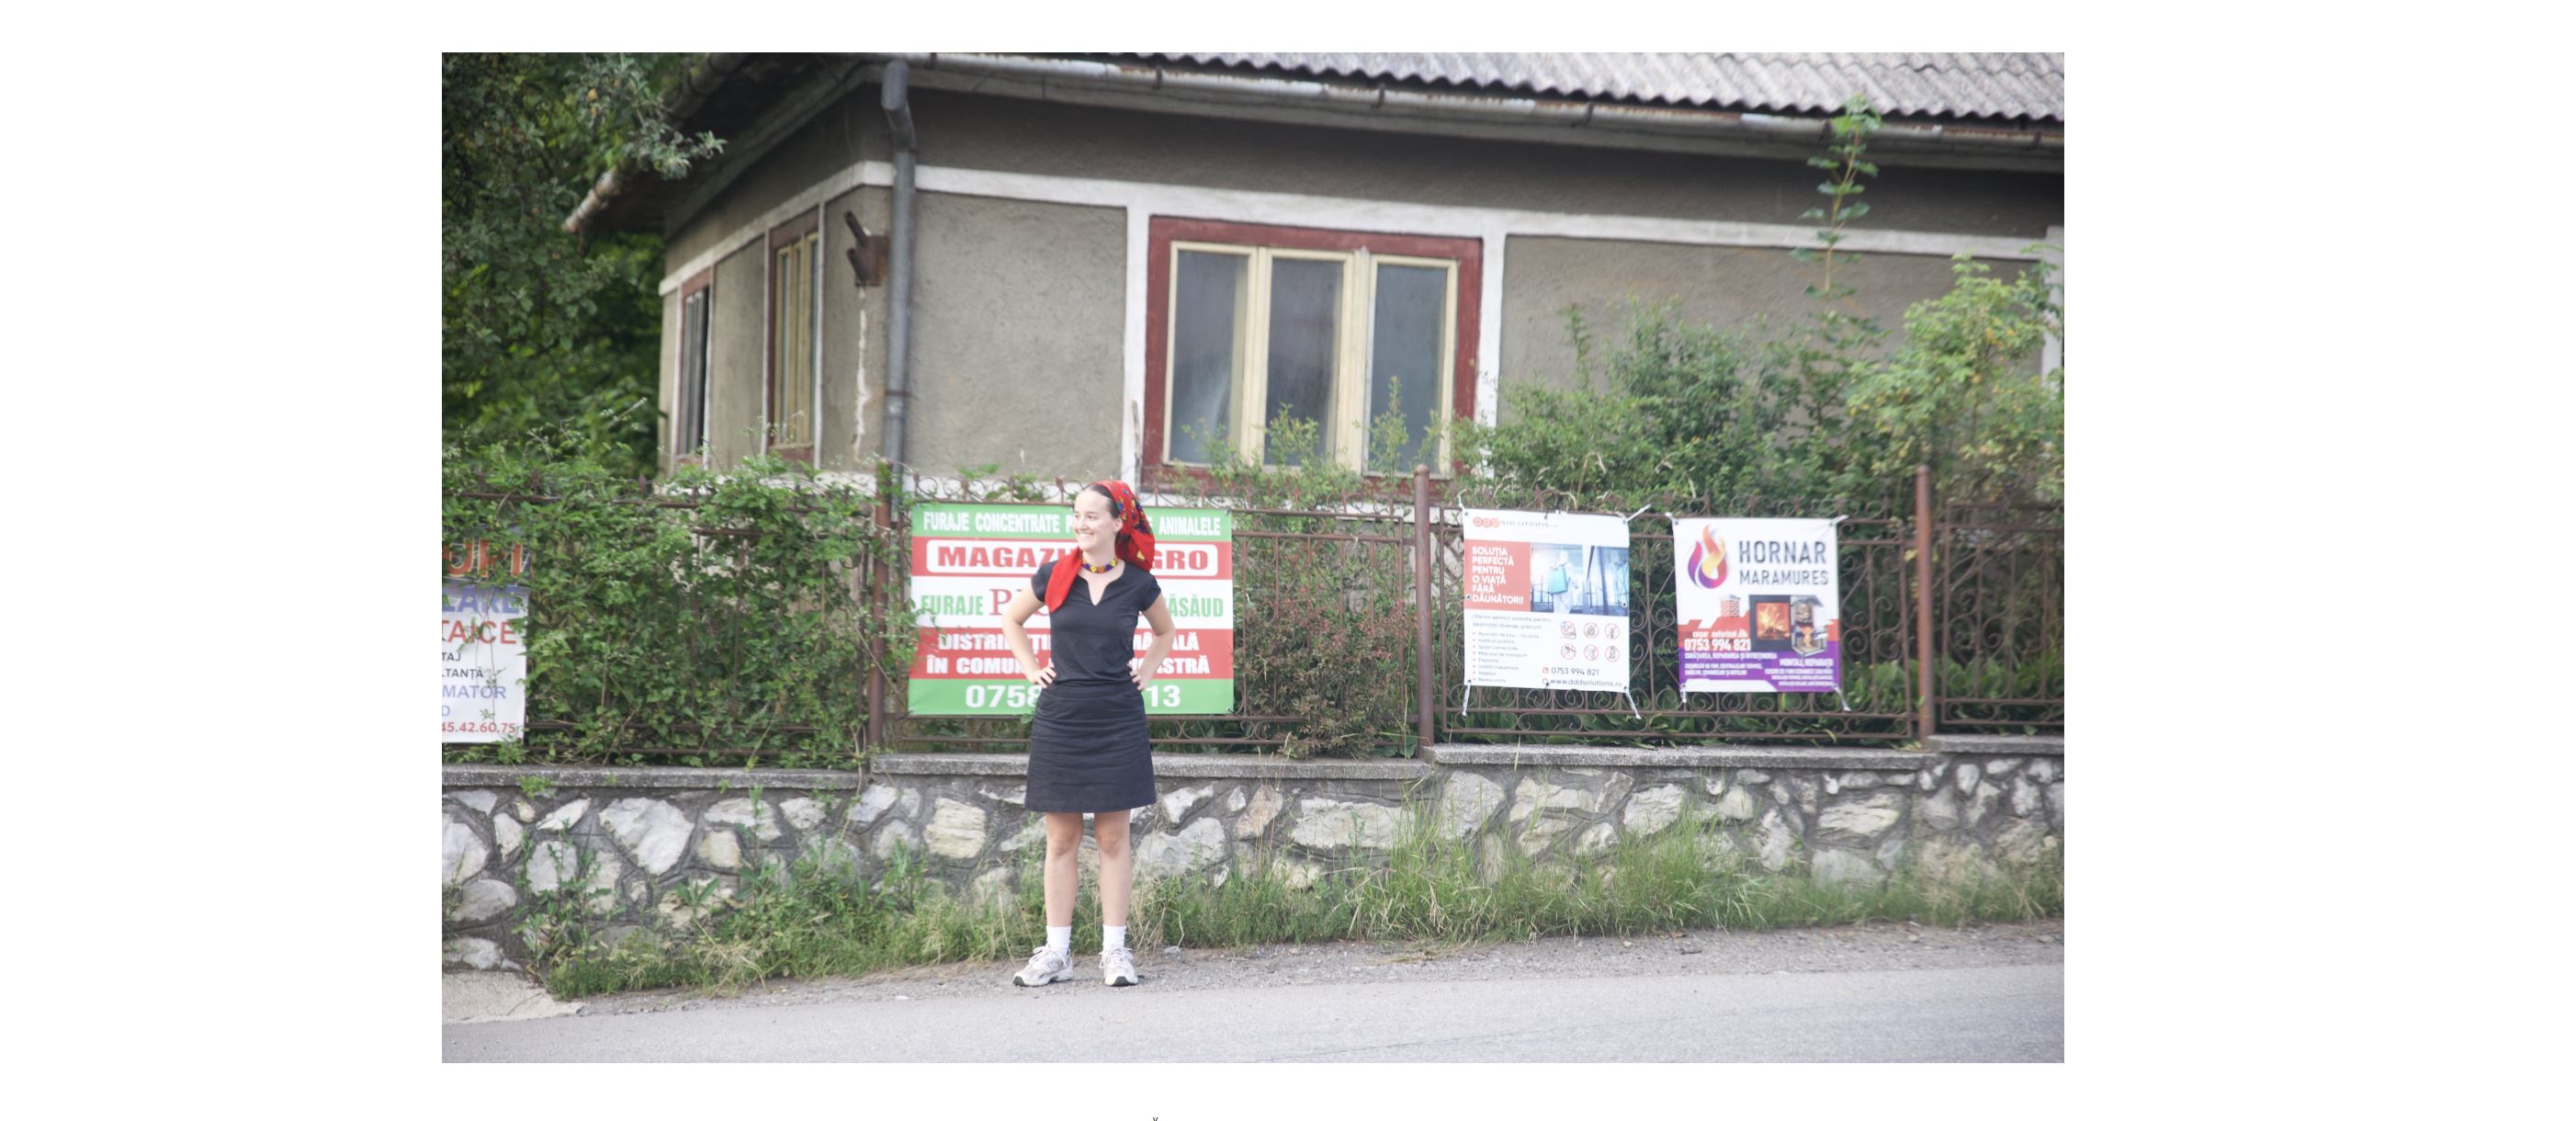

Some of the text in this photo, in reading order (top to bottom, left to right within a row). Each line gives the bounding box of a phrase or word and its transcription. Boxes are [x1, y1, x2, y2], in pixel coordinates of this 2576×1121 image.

[923, 512, 969, 531] FURAJE
[976, 513, 1059, 533] CONCENTRATE
[1158, 516, 1220, 536] ANIMALELE
[1473, 547, 1508, 557] SOLUȚIA
[1739, 540, 1826, 563] HORNAR
[1473, 556, 1514, 566] PERFECTĂ
[1473, 566, 1505, 574] PENTRU
[1473, 575, 1507, 586] O VIAȚĂ
[1740, 570, 1828, 585] MARAMURES
[1473, 583, 1495, 594] FĂRĂ
[921, 595, 984, 616] FURAJE
[1168, 593, 1224, 617] ĂSĂUD
[1684, 638, 1751, 651] 0753 994 821
[927, 654, 948, 674] ÎN
[1551, 666, 1599, 676] 0753 994 821
[443, 685, 506, 699] MATOR
